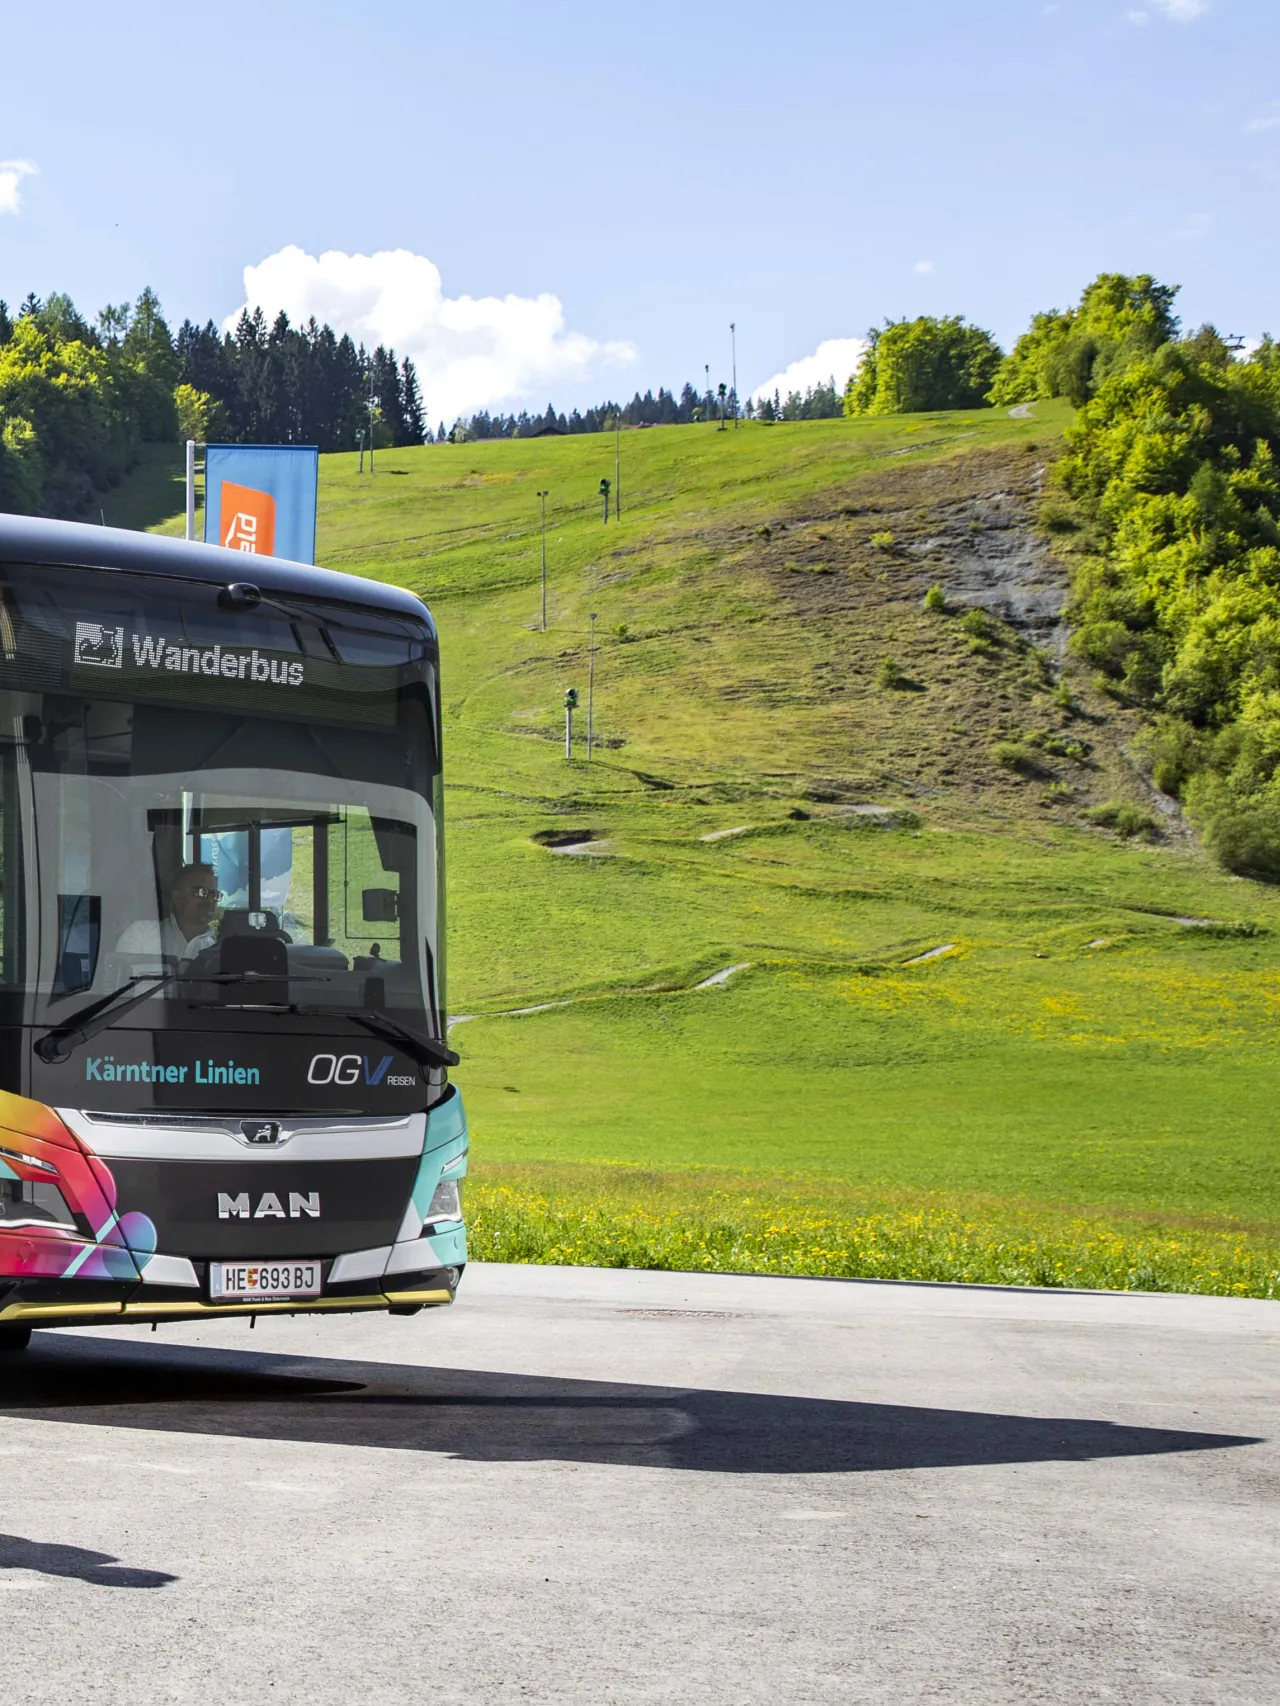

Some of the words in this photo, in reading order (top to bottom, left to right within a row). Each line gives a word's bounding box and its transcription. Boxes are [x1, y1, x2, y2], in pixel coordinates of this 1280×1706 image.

[132, 634, 304, 685] Wanderbus
[86, 1056, 188, 1084] Kärntner
[195, 1059, 260, 1085] Linien
[307, 1054, 394, 1086] OGV
[387, 1076, 415, 1087] REISEN
[218, 1192, 320, 1219] MAN
